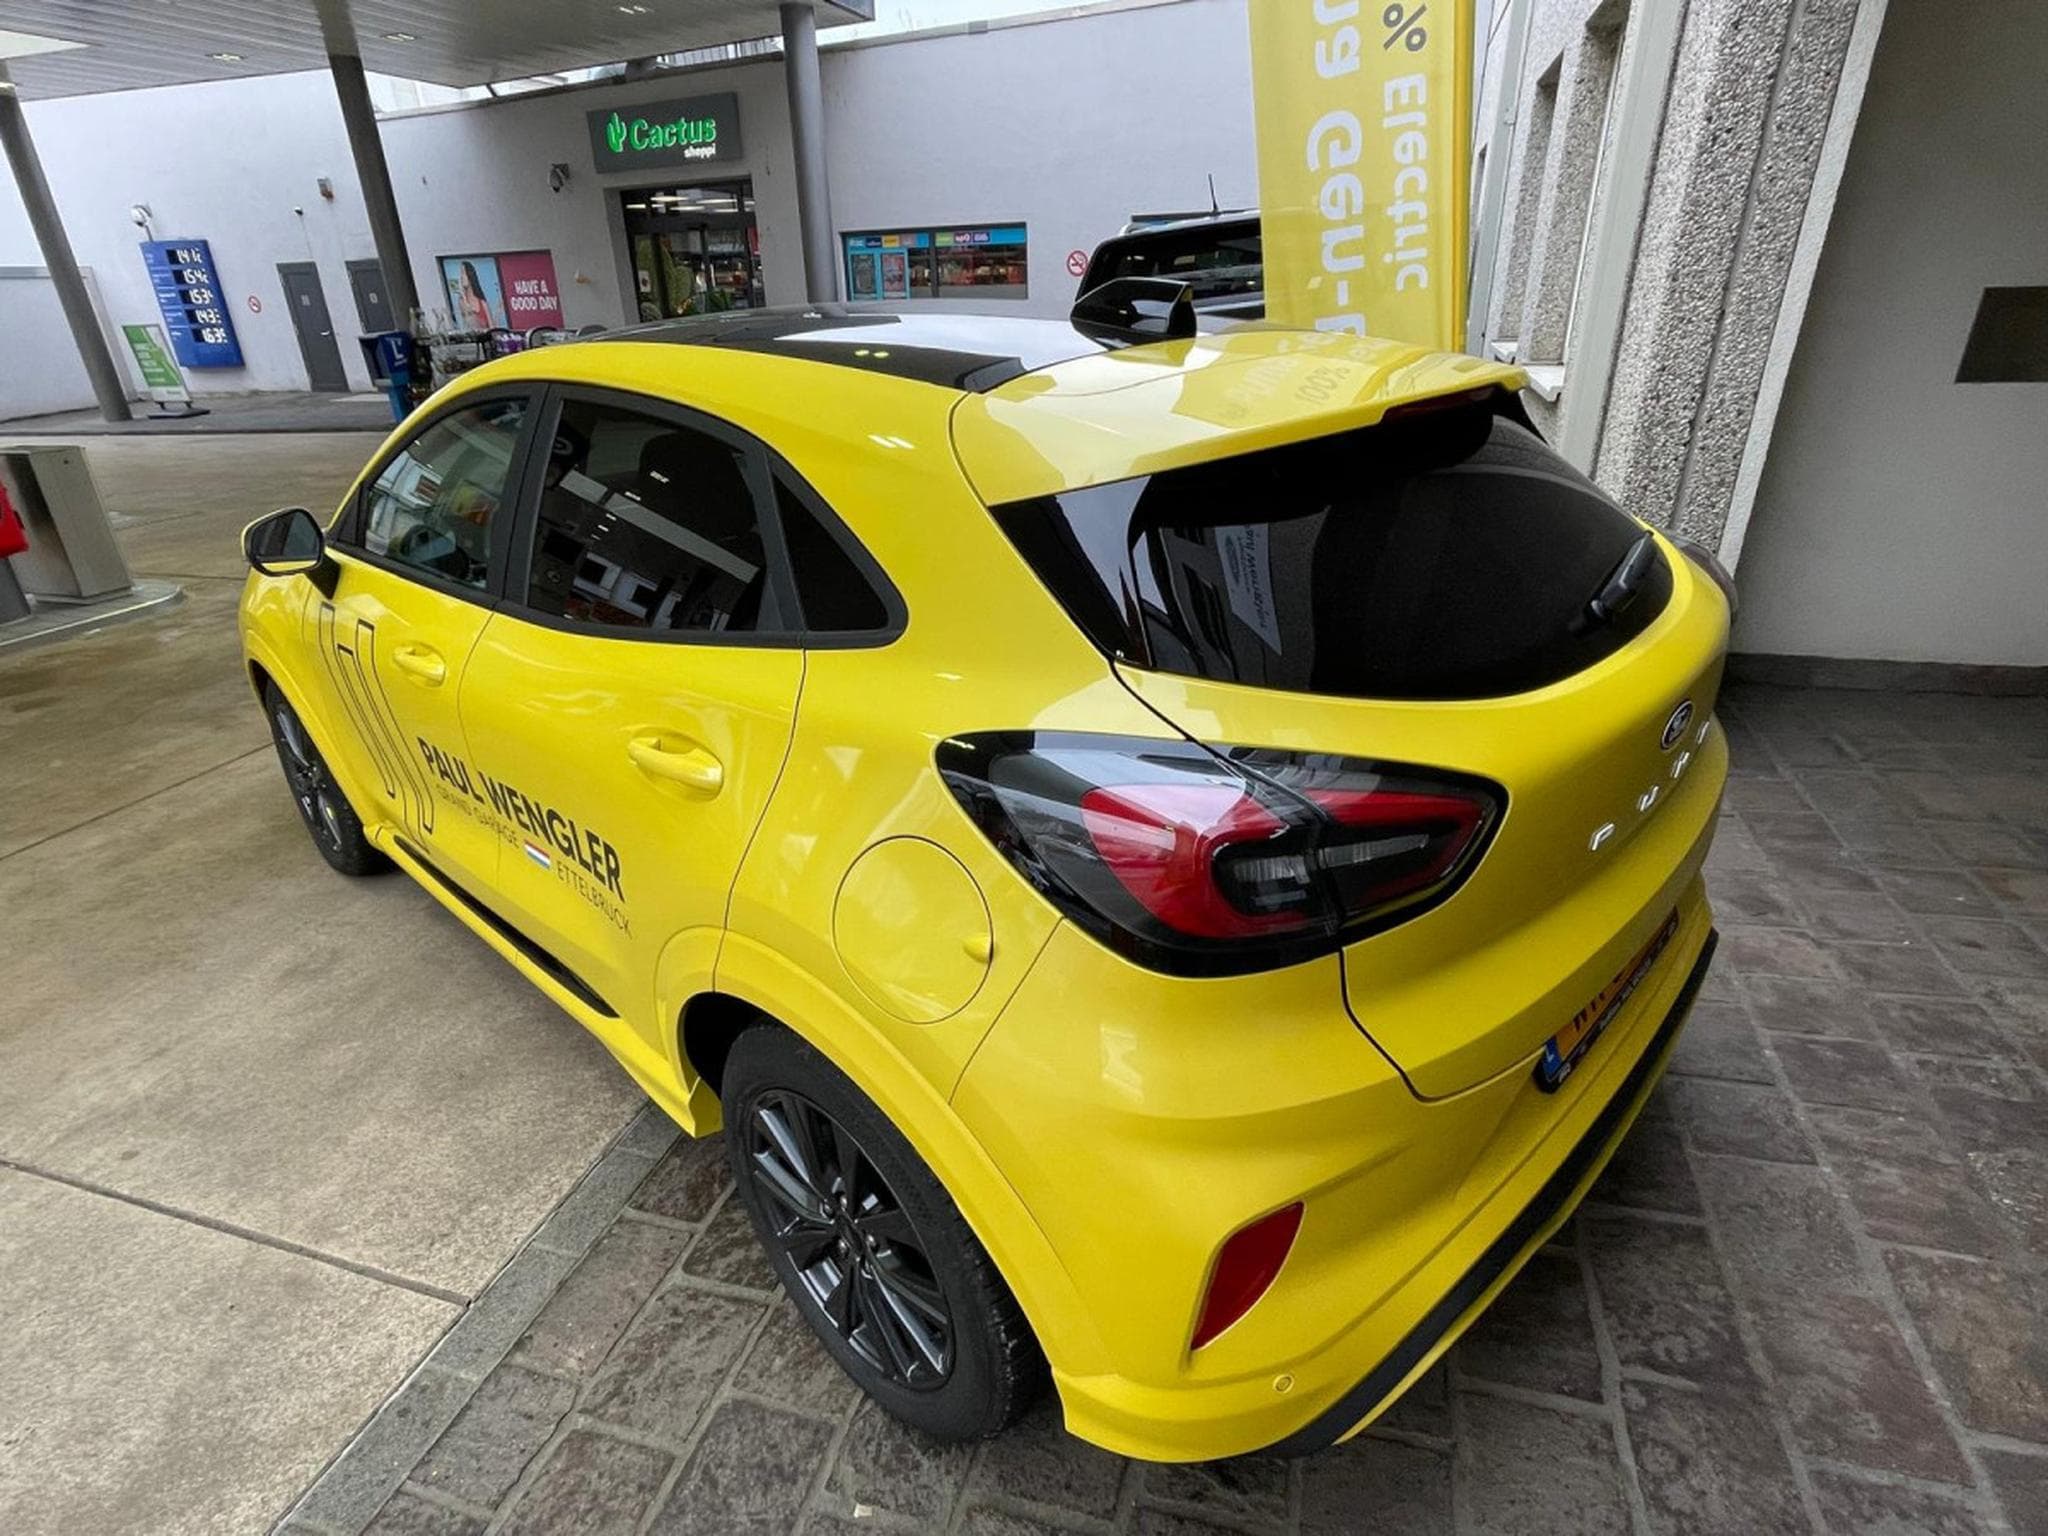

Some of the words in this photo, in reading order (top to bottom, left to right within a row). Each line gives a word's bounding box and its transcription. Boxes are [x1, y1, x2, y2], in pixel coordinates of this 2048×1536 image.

[629, 117, 717, 151] Cactus
[510, 296, 537, 311] GOOD
[538, 295, 558, 310] DAY
[514, 281, 539, 295] HAVE
[540, 279, 549, 294] A
[417, 736, 486, 805] PAUL
[478, 770, 626, 904] WENGLER
[556, 859, 633, 940] ETTELBRUCK
